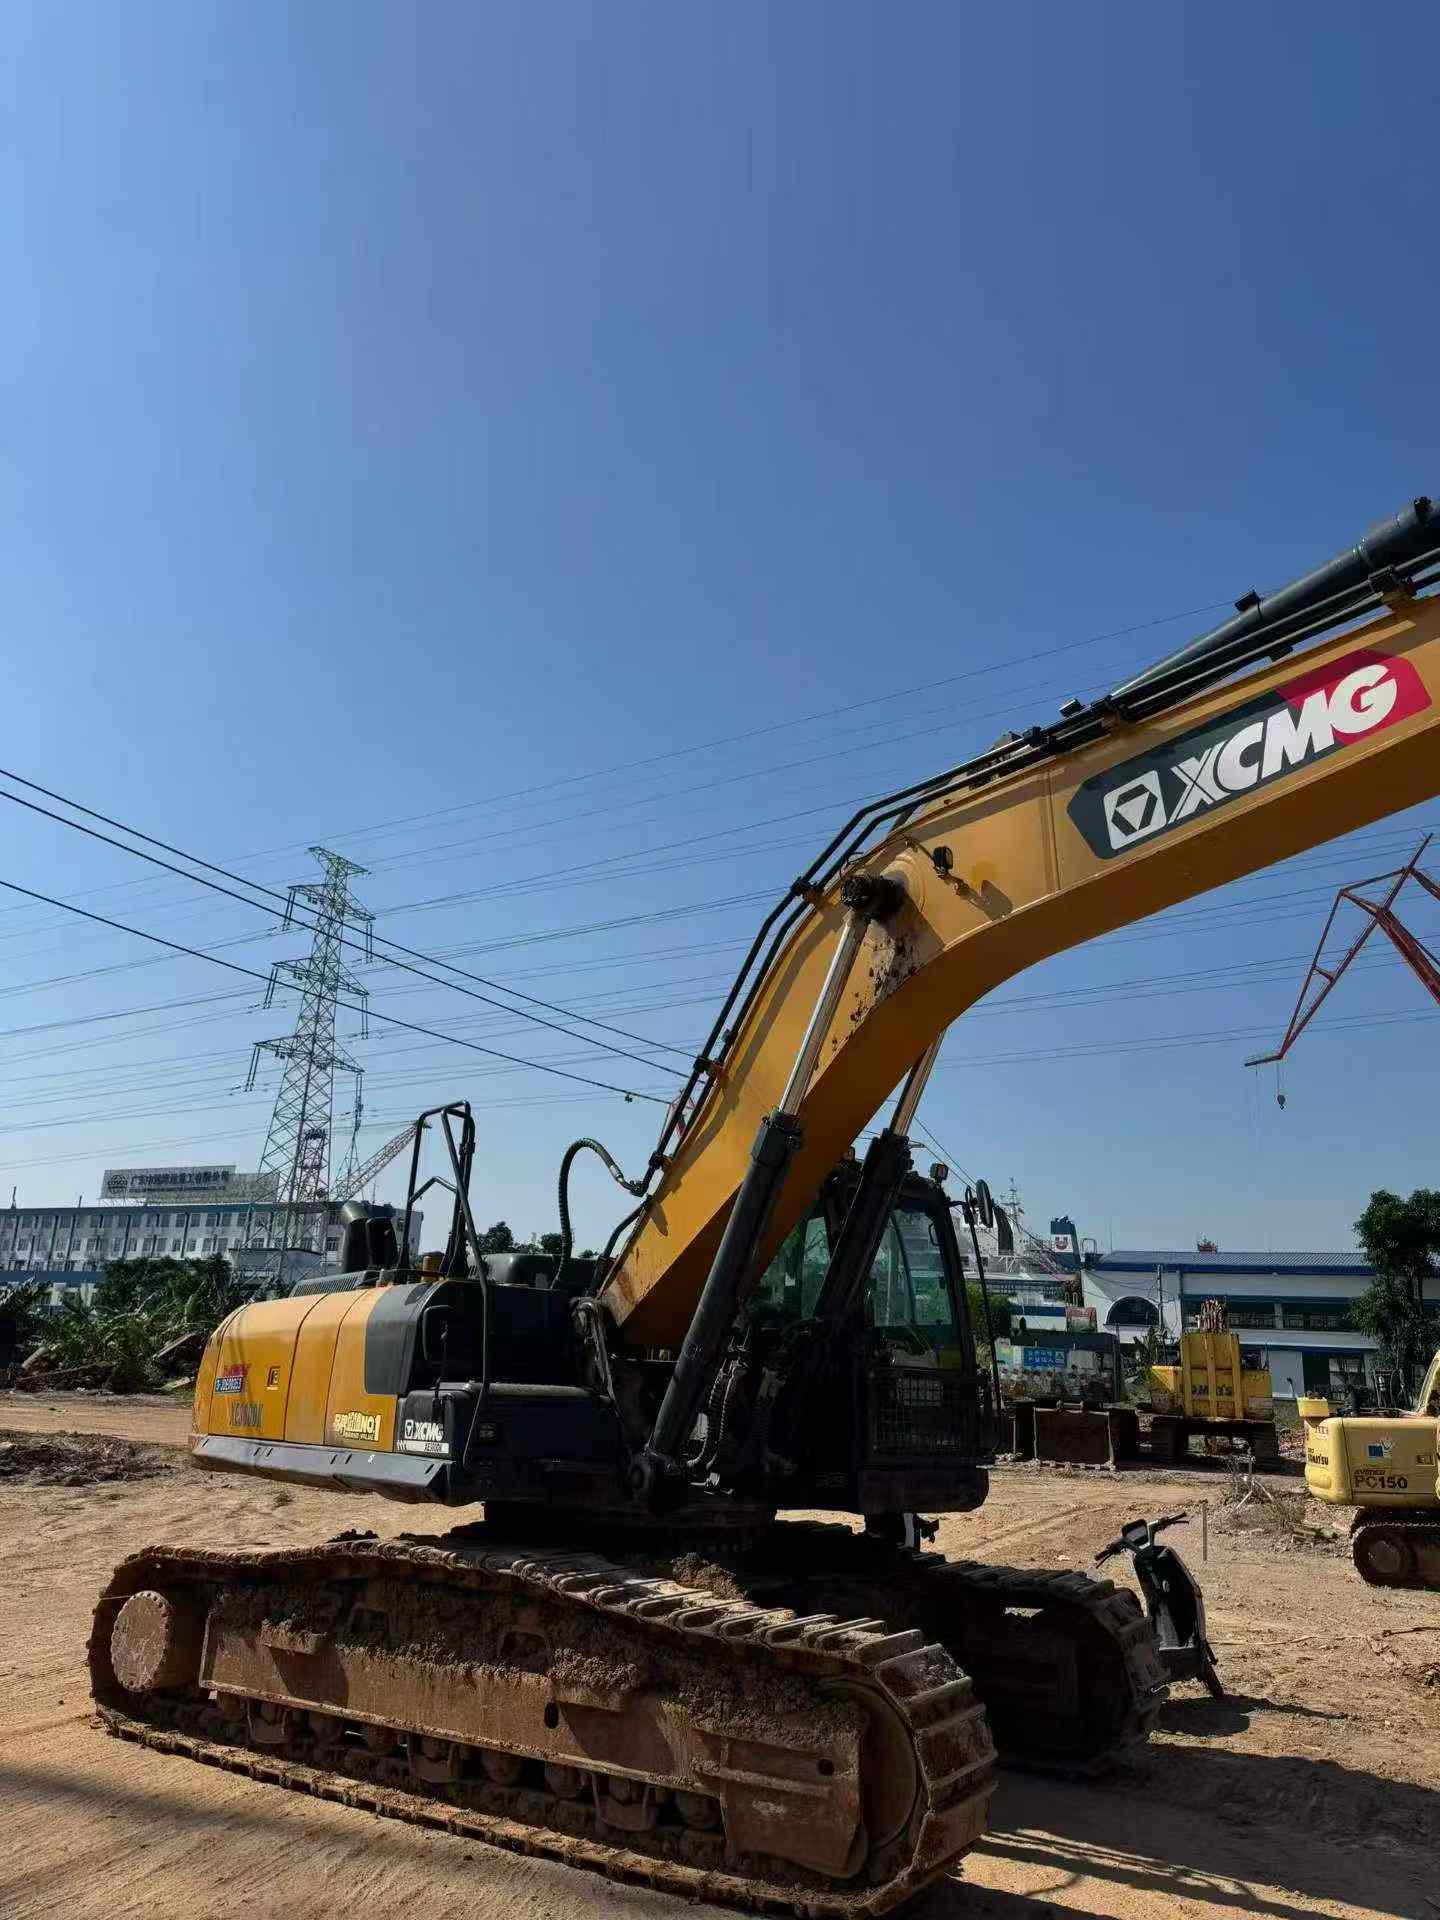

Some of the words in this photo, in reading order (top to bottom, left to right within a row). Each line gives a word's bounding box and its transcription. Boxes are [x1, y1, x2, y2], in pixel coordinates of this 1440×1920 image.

[1168, 664, 1398, 824] XCMG
[414, 1421, 444, 1442] XCMG
[1353, 1475, 1408, 1489] PC150
